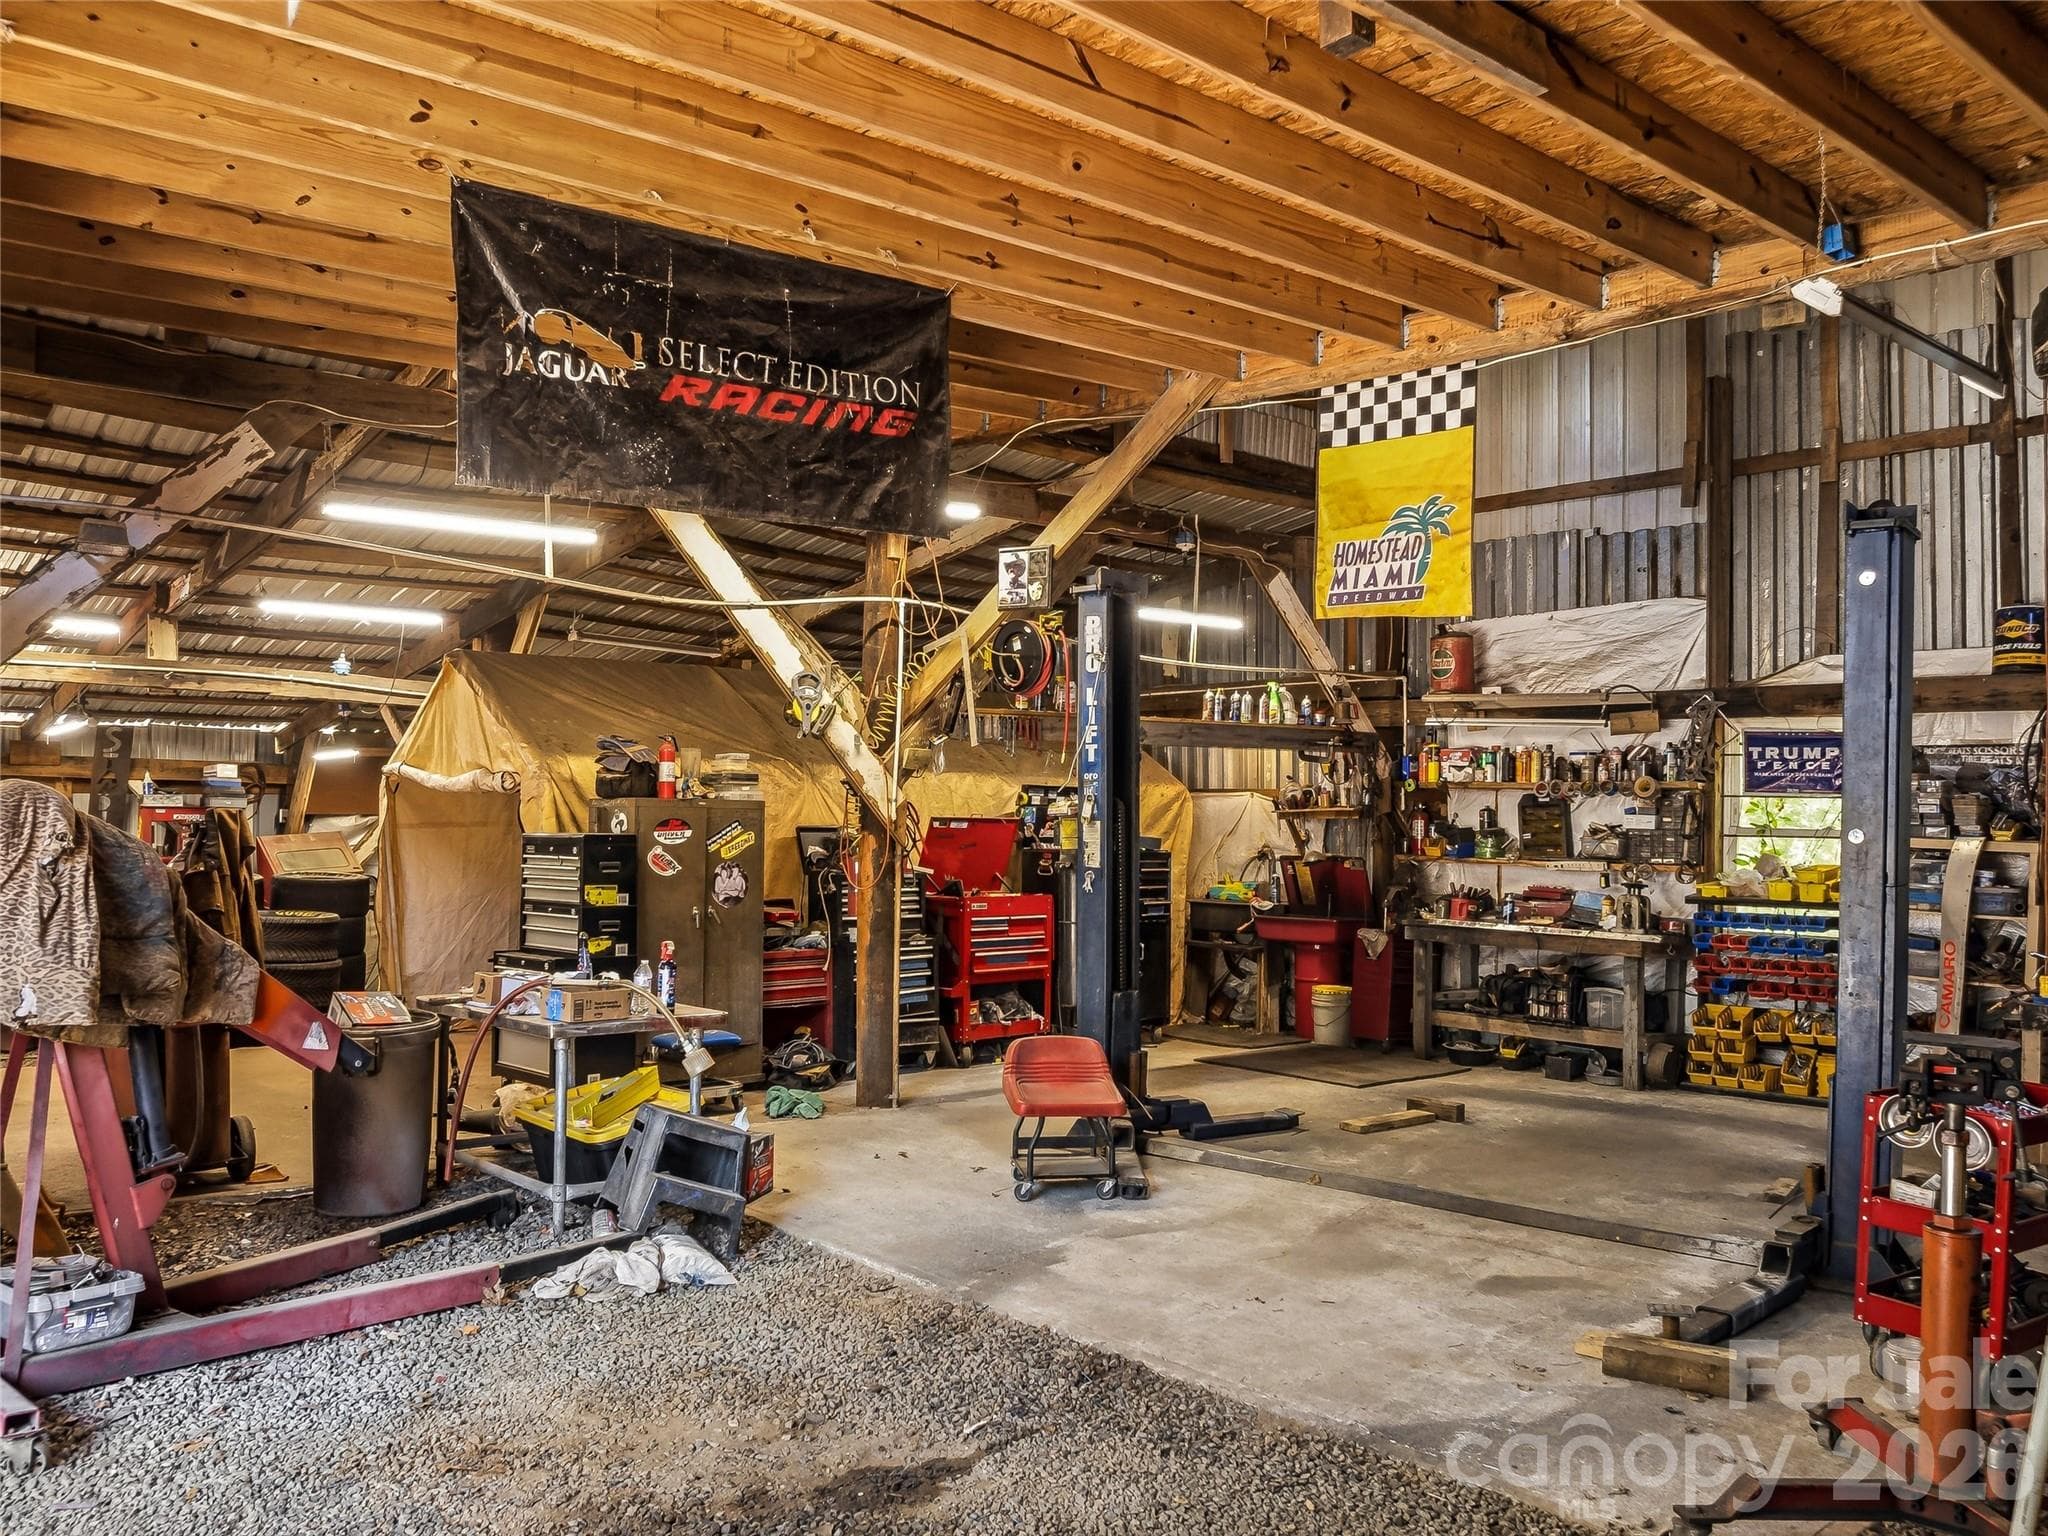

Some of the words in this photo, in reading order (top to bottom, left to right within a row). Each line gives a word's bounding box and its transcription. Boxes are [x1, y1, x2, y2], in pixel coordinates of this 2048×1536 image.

[502, 342, 630, 388] JAGUAR
[659, 337, 779, 385] SELECT
[780, 360, 922, 407] EDITION
[658, 374, 919, 437] RACING
[1334, 535, 1423, 567] HOMESTEAD
[1331, 563, 1416, 591] MIAMI
[1331, 588, 1421, 605] SPEEDWAY
[1085, 615, 1102, 673] PRO
[2012, 642, 2042, 650] FUELS
[1085, 687, 1099, 761] LIFT
[1749, 747, 1840, 759] TRUMP
[1757, 761, 1830, 770] PENCE
[1939, 941, 1956, 1029] CAMARO
